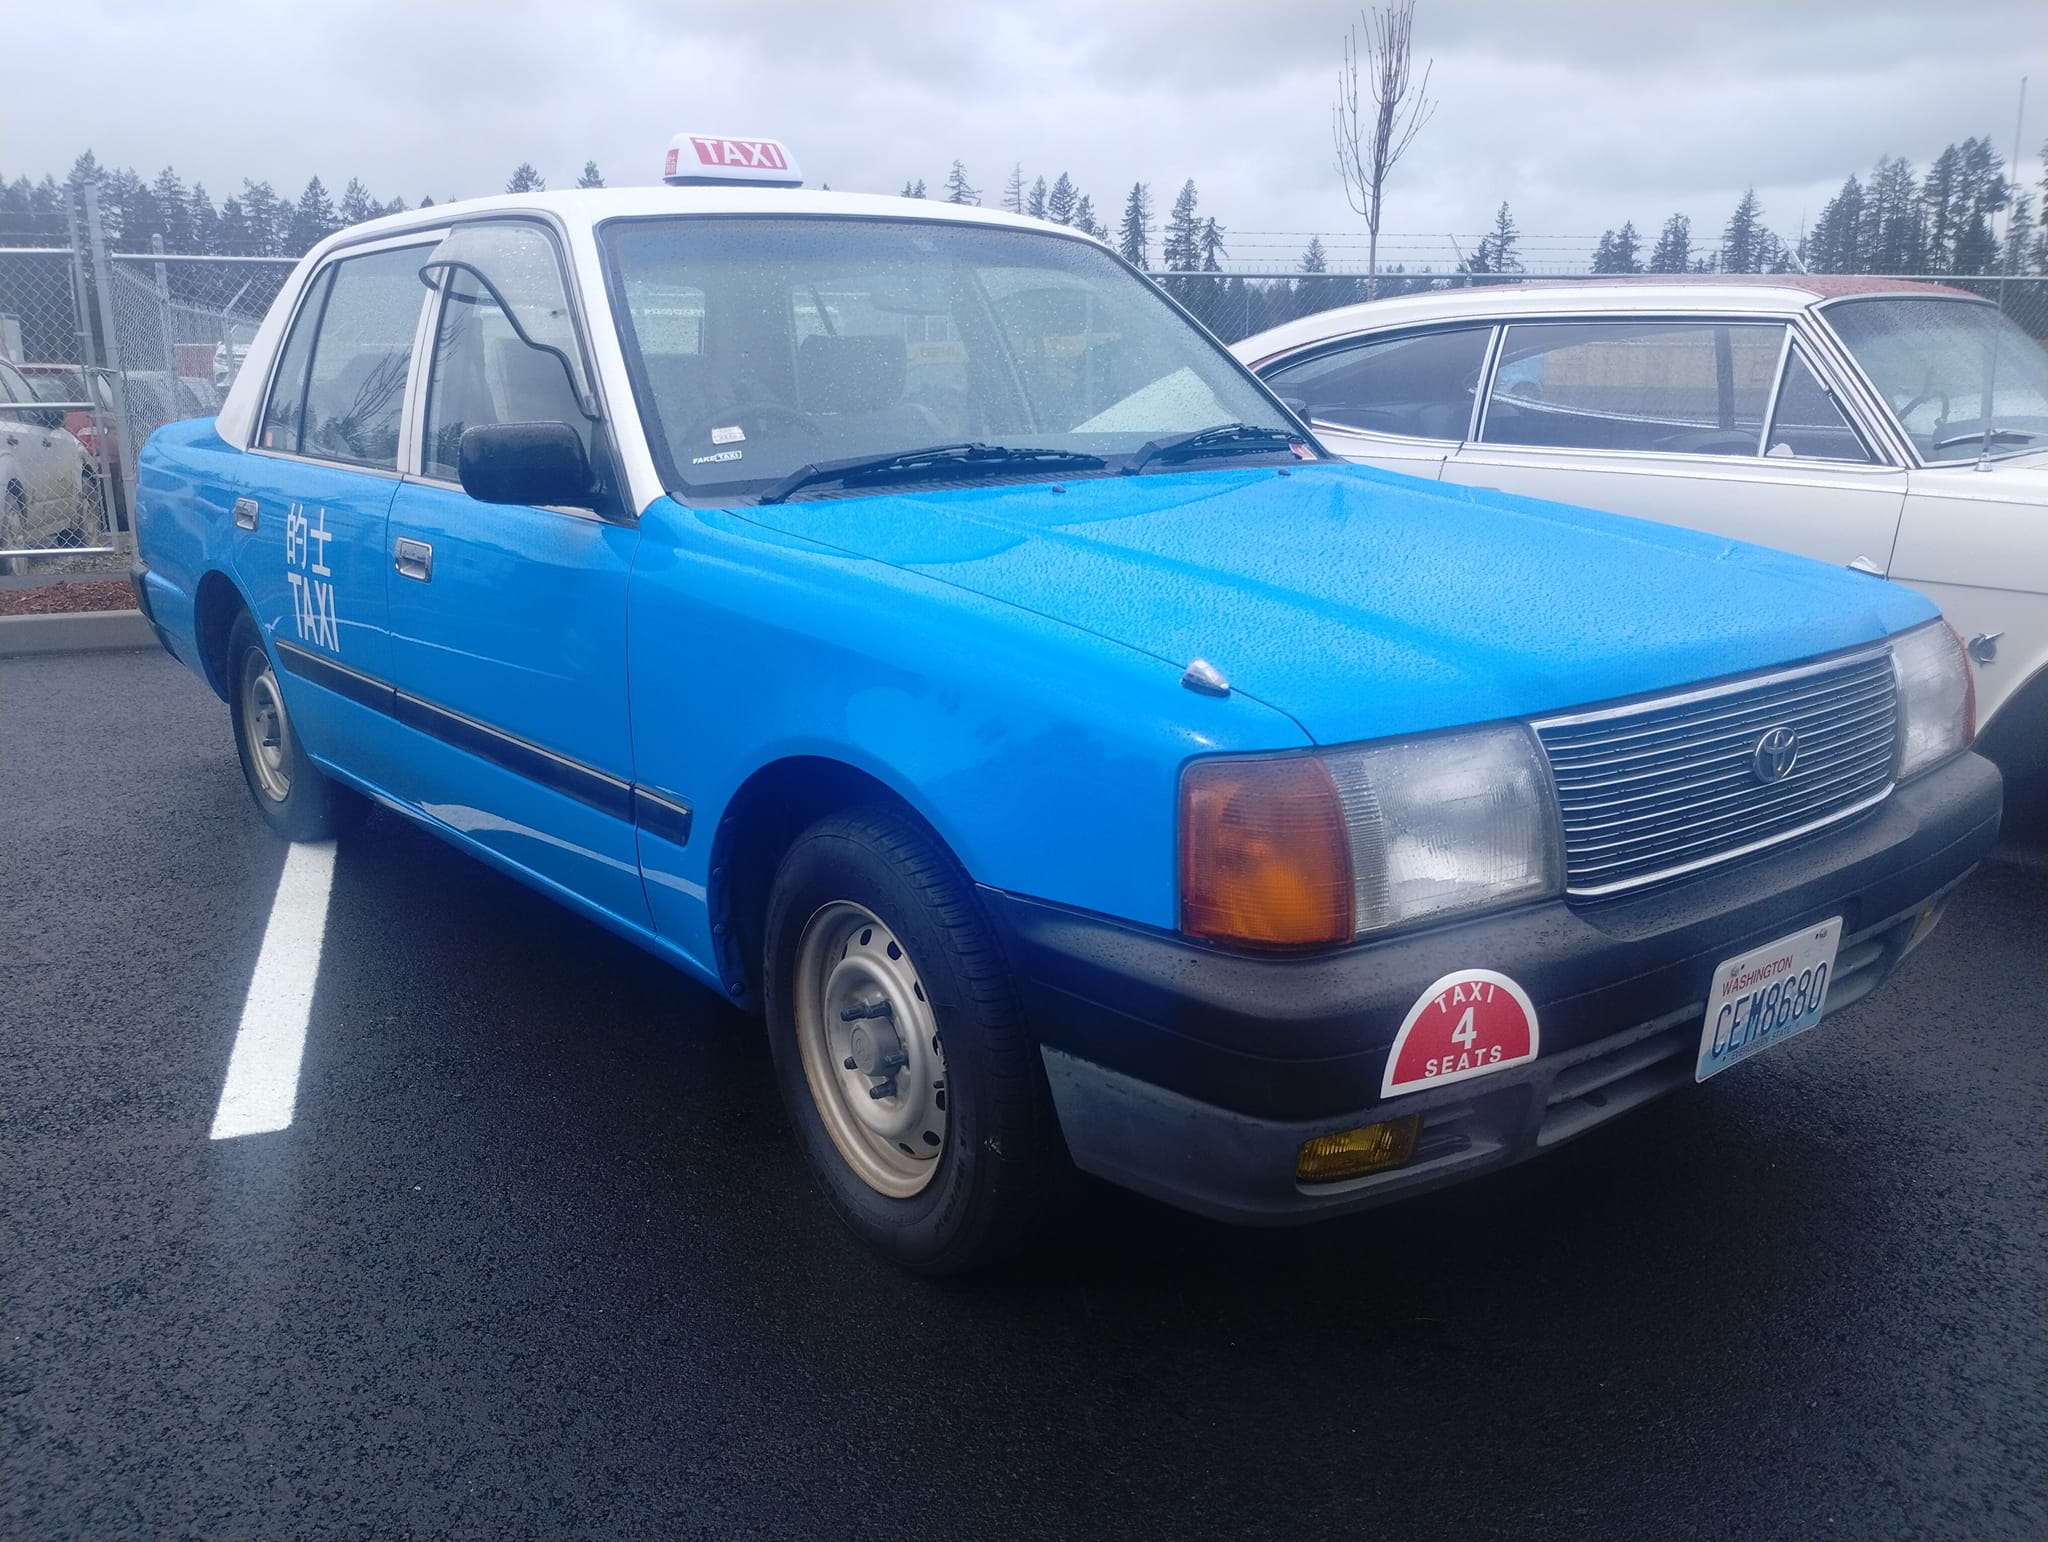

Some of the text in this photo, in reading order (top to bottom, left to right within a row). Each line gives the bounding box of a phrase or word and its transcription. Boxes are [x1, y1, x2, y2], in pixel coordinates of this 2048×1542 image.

[695, 139, 784, 168] TAXI
[692, 451, 742, 465] FAKE TAXI
[286, 502, 333, 578] 的士
[287, 571, 340, 654] TAXI
[1722, 954, 1794, 997] WASHINGTON
[1433, 982, 1495, 1014] TAXI
[1711, 961, 1828, 1058] CEM8680
[1451, 1006, 1478, 1050] 4
[1424, 1045, 1503, 1078] SEATS
